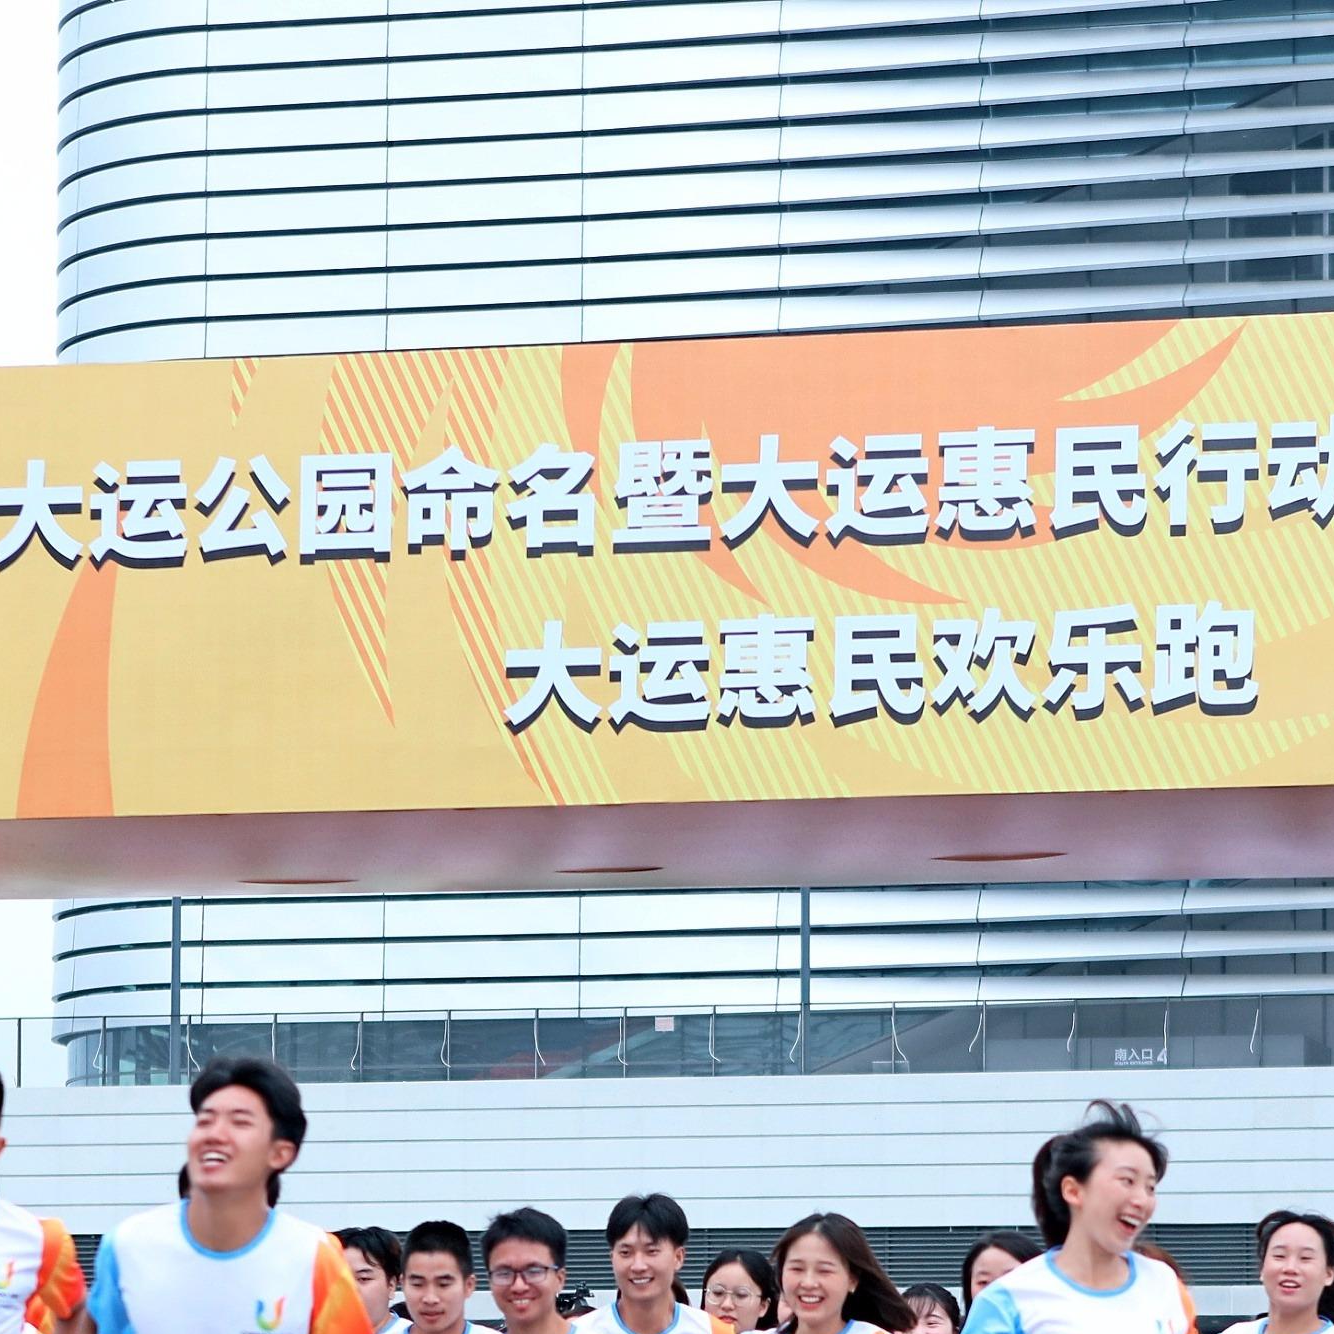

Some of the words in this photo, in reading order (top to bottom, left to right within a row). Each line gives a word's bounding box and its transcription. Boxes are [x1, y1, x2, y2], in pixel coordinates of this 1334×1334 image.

[504, 601, 1260, 733] 大运惠民欢乐跑
[1114, 1048, 1154, 1061] 南入口
